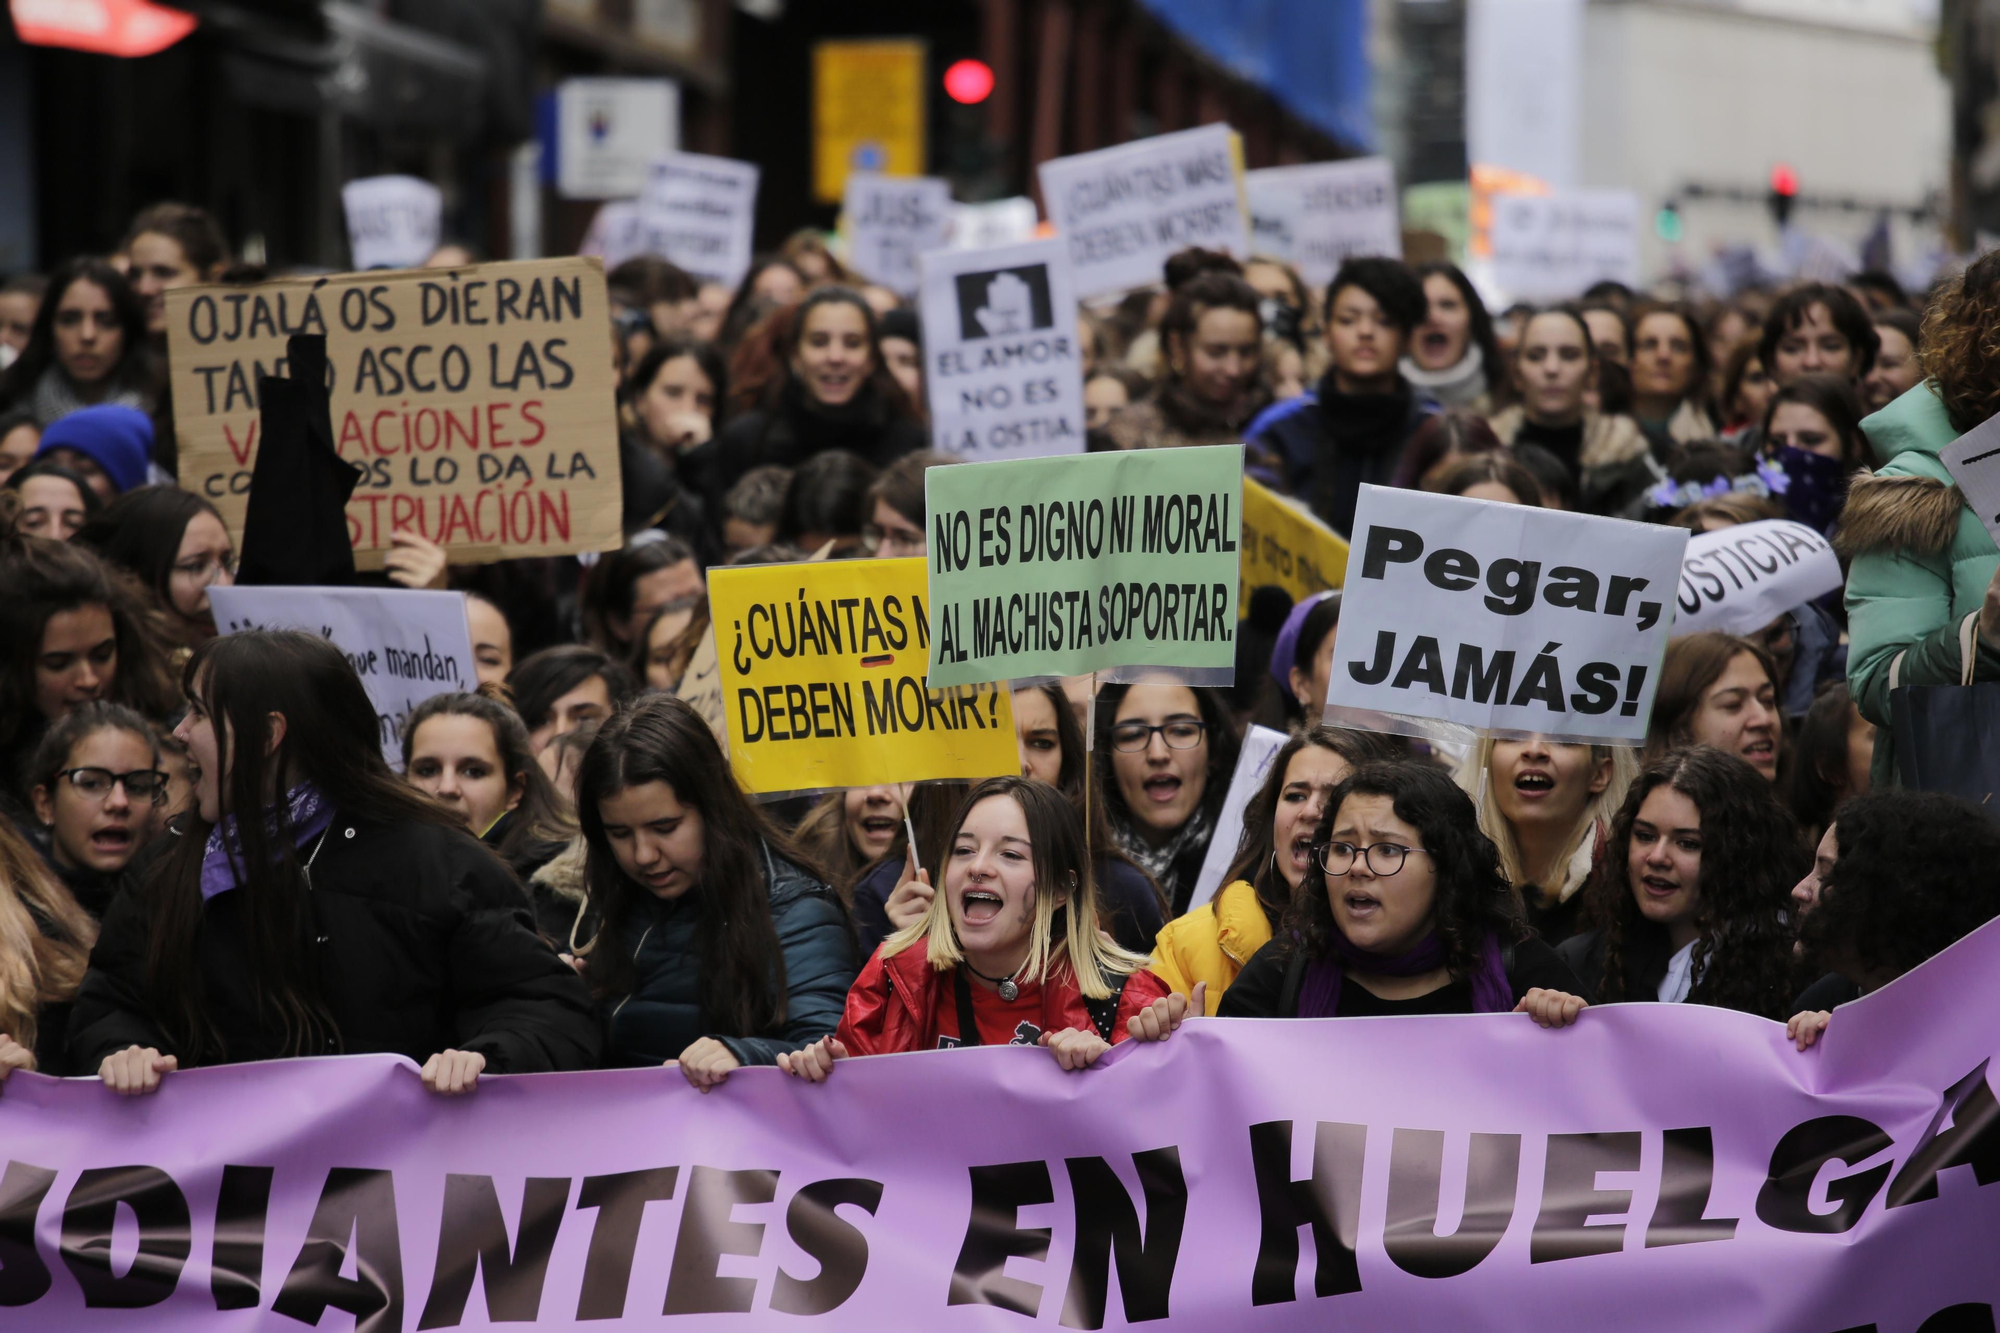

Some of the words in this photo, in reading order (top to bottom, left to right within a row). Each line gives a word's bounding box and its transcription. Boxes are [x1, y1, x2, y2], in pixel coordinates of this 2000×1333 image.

[189, 278, 327, 344] OJALÁ
[340, 286, 396, 332] OS
[354, 345, 471, 397] ASCO
[489, 338, 575, 391] LAS
[939, 352, 970, 377] EL
[980, 337, 1070, 369] AMOR
[962, 385, 1011, 412] NO
[1024, 379, 1057, 404] ES
[410, 456, 458, 487] LO
[478, 452, 532, 483] DA
[547, 451, 596, 480] LA
[943, 430, 978, 454] LA
[935, 510, 971, 574] NO
[979, 505, 1011, 566] ES
[1019, 498, 1102, 563] DIGNO
[1110, 494, 1135, 554] NI
[1141, 493, 1236, 554] MORAL
[1361, 525, 1663, 632] Pegar,
[1673, 524, 1826, 625] USTICIA!
[733, 588, 908, 675] ¿CUÁNTAS
[938, 602, 968, 665] AL
[973, 590, 1093, 660] MACHISTA
[1099, 582, 1233, 645] SOPORTAR.
[385, 633, 466, 690] mandan,
[1347, 630, 1648, 717] JAMÁS!
[739, 680, 856, 743] DEBEN
[864, 675, 999, 737] MORIR?
[946, 1145, 1188, 1331] EN
